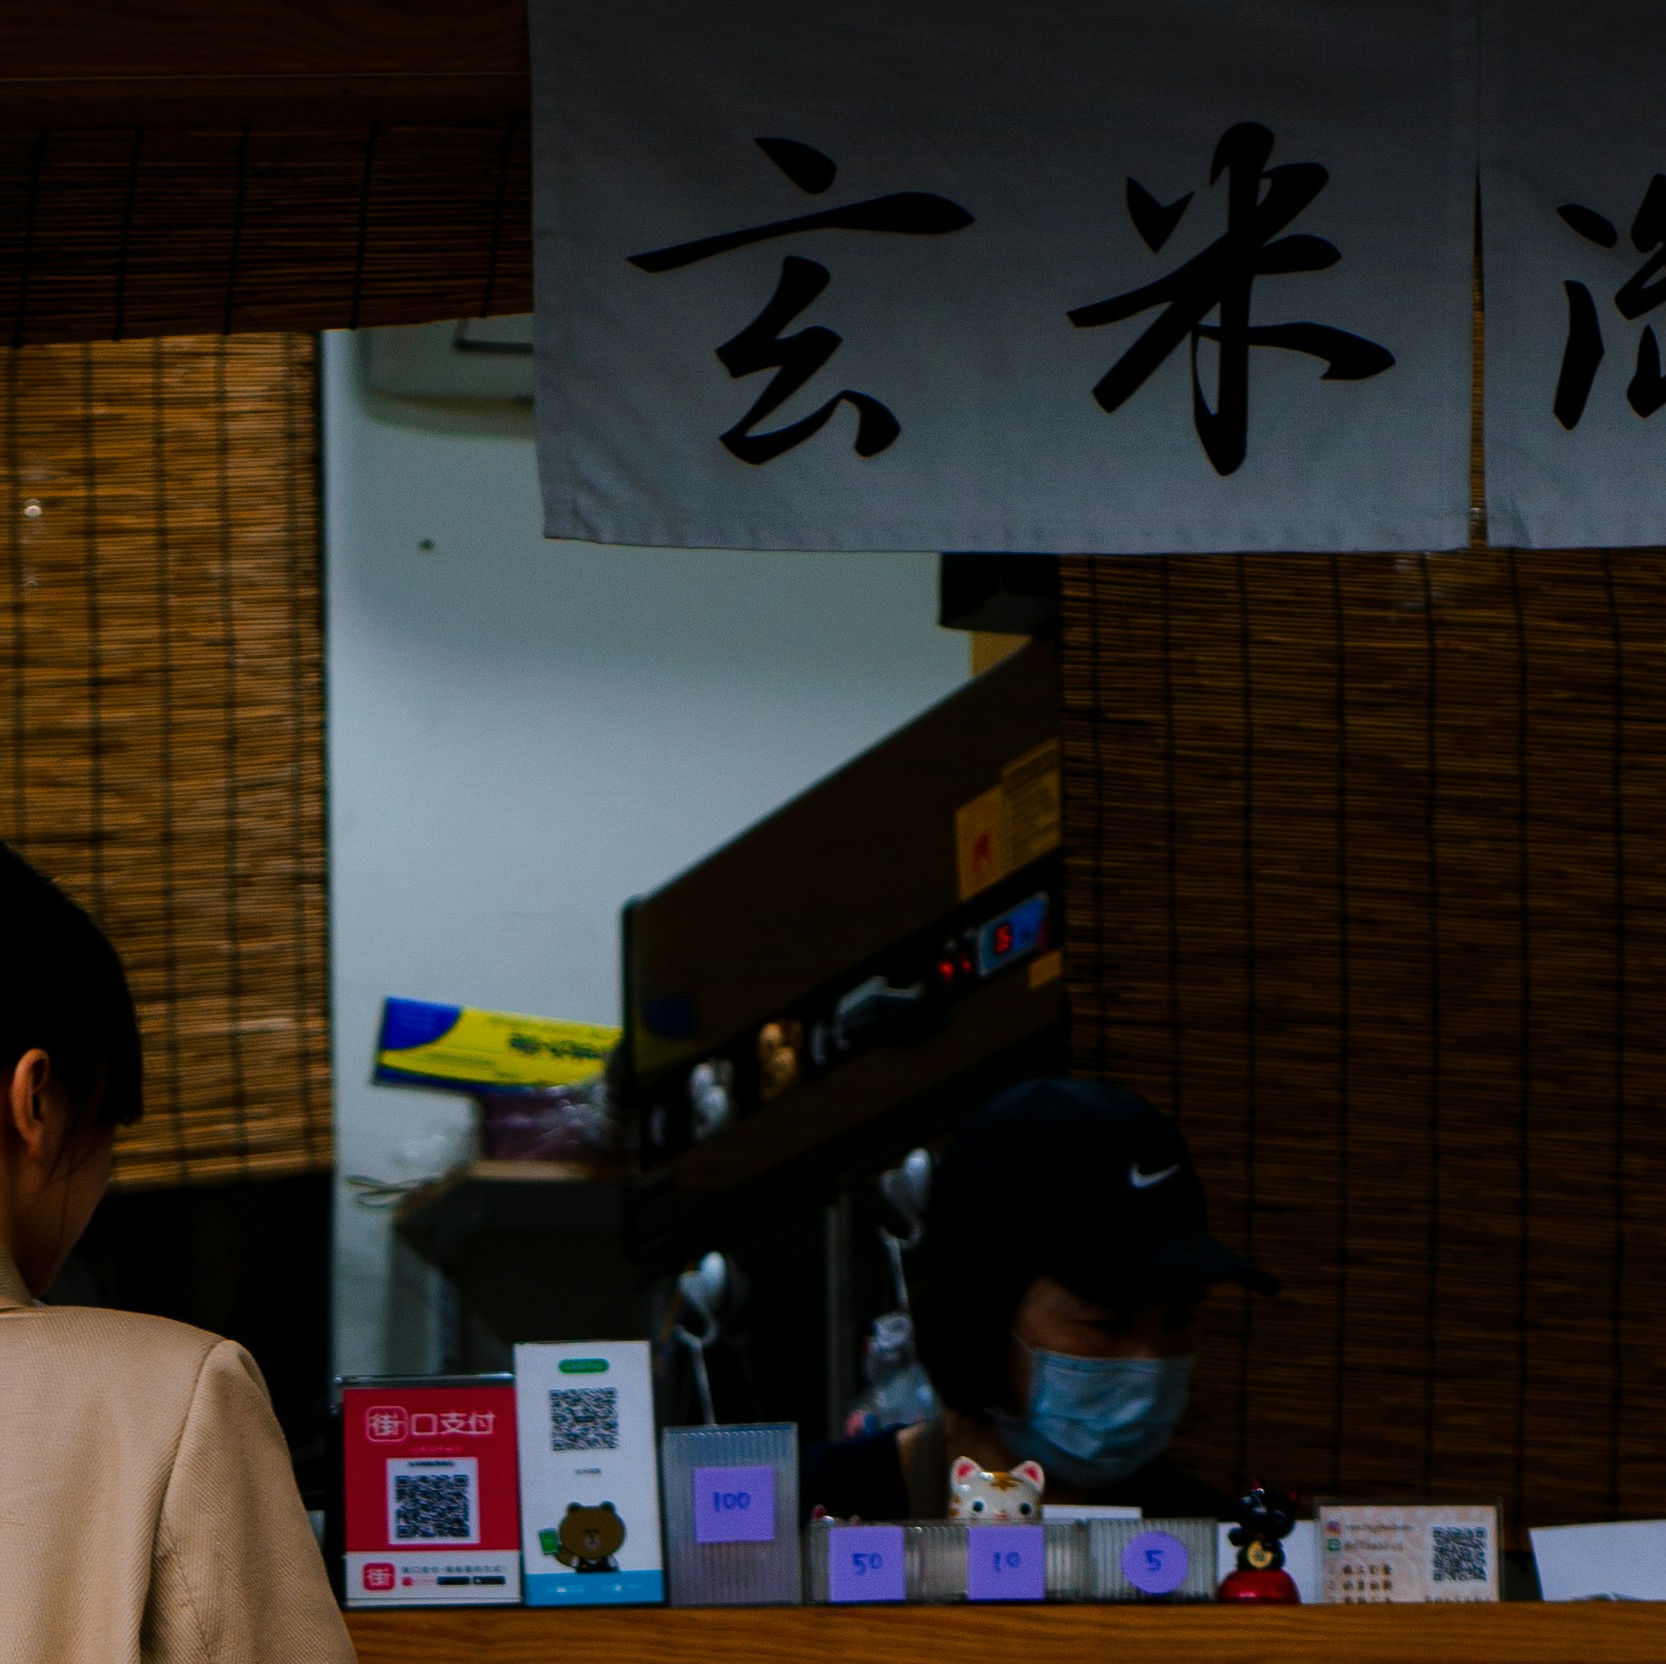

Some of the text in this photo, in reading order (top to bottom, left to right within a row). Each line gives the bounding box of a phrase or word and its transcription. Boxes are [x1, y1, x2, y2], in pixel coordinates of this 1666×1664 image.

[369, 1411, 496, 1437] 街口支付
[713, 1491, 751, 1513] 100
[851, 1551, 884, 1576] 50
[991, 1550, 1021, 1574] 10
[1144, 1548, 1165, 1574] 5
